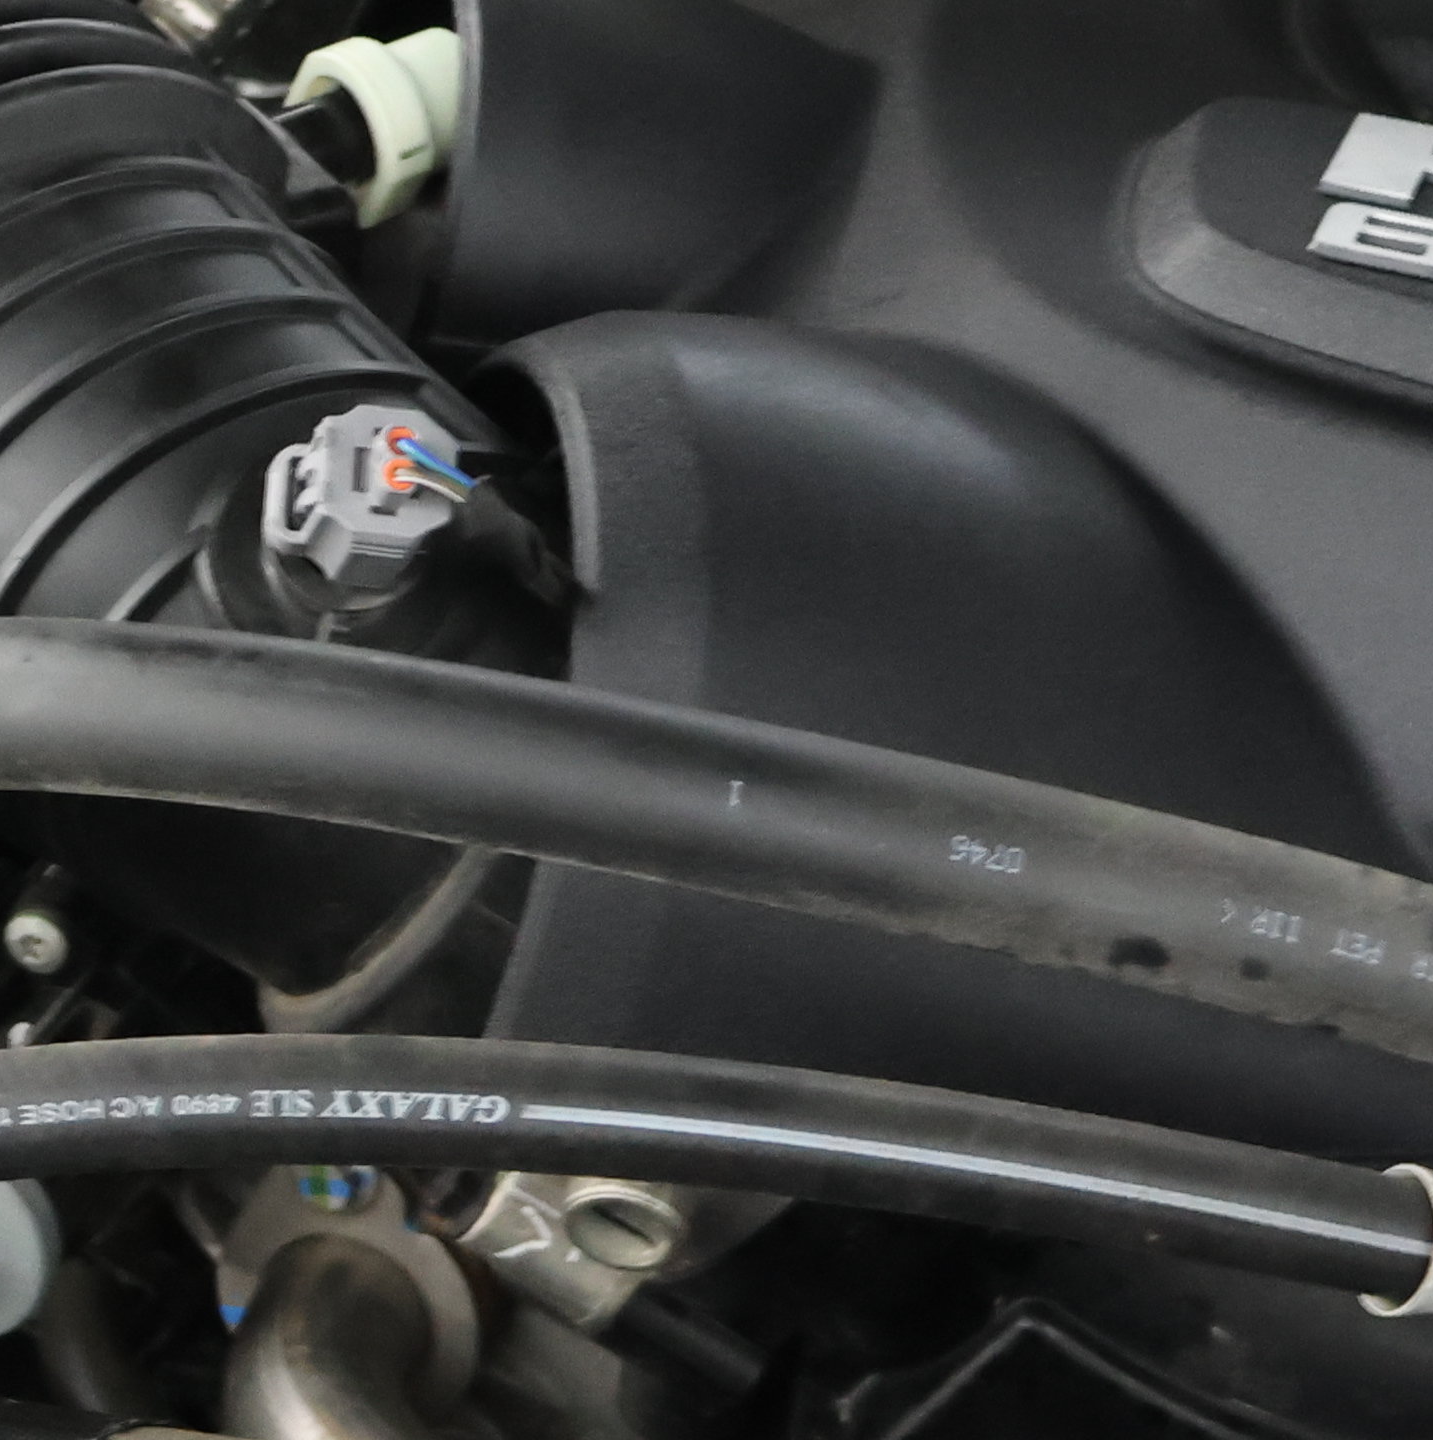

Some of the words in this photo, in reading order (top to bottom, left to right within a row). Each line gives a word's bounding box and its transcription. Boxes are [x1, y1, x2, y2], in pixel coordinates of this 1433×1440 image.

[17, 1098, 106, 1126] HOSE
[108, 1095, 163, 1119] A/C
[248, 1088, 315, 1118] SLE
[315, 1088, 511, 1124] GALAXY
